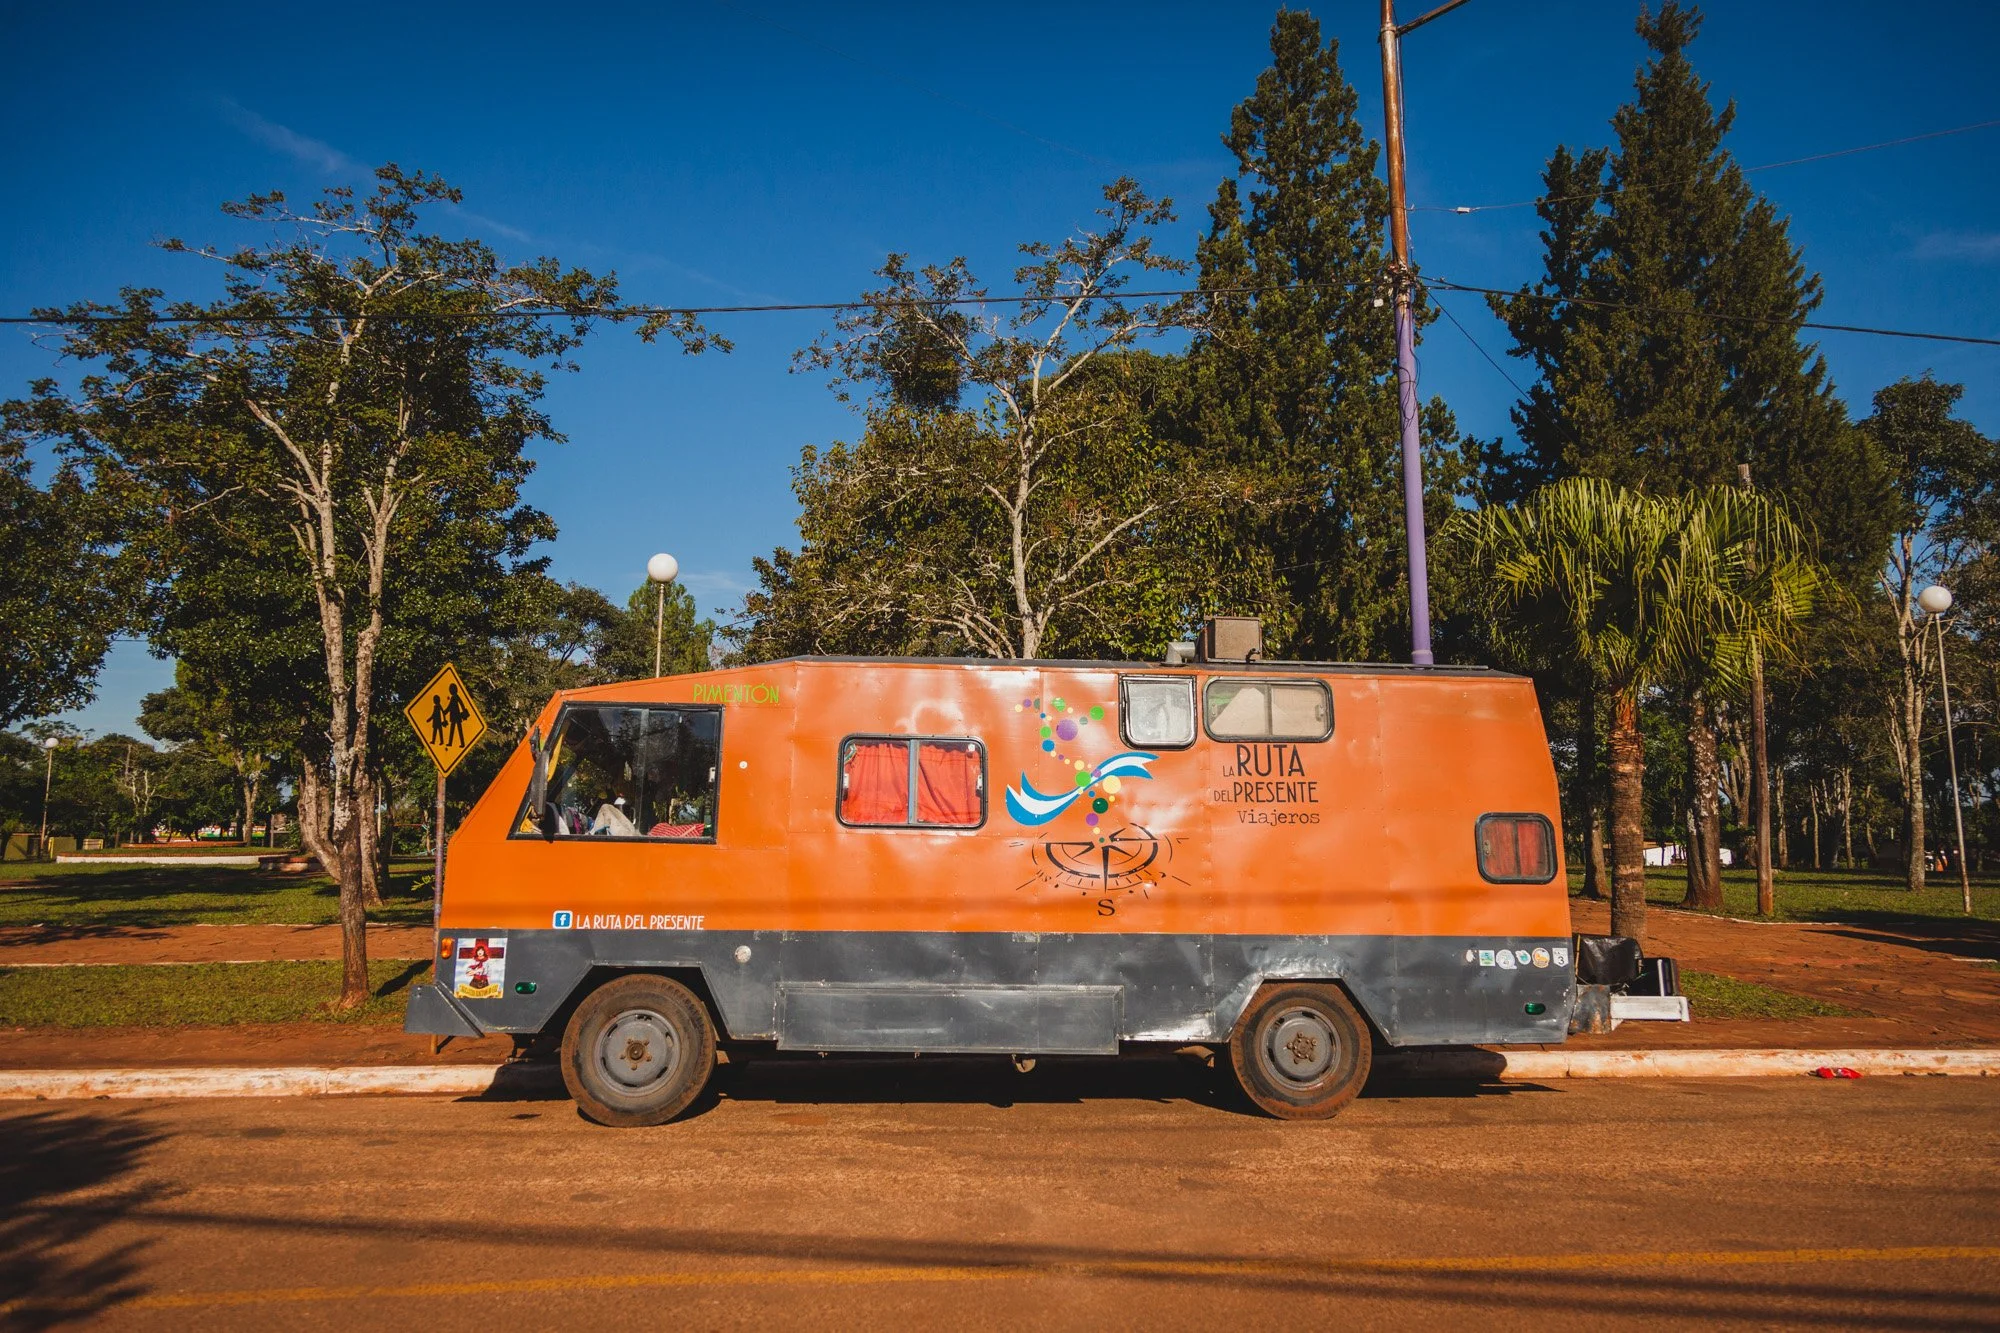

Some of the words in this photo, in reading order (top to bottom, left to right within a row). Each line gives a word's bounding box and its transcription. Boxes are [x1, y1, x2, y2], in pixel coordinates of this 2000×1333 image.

[693, 682, 780, 703] PIMENTÓN
[1222, 765, 1235, 777] LA
[1236, 744, 1305, 777] RUTA
[1213, 790, 1233, 802] DEL
[1233, 781, 1319, 803] PRESENTE
[1237, 809, 1321, 827] Viajeros
[1097, 898, 1116, 917] S
[576, 914, 590, 930] LA
[593, 914, 622, 930] RUTA
[624, 914, 648, 930] DEL
[650, 914, 705, 930] PRESENTE
